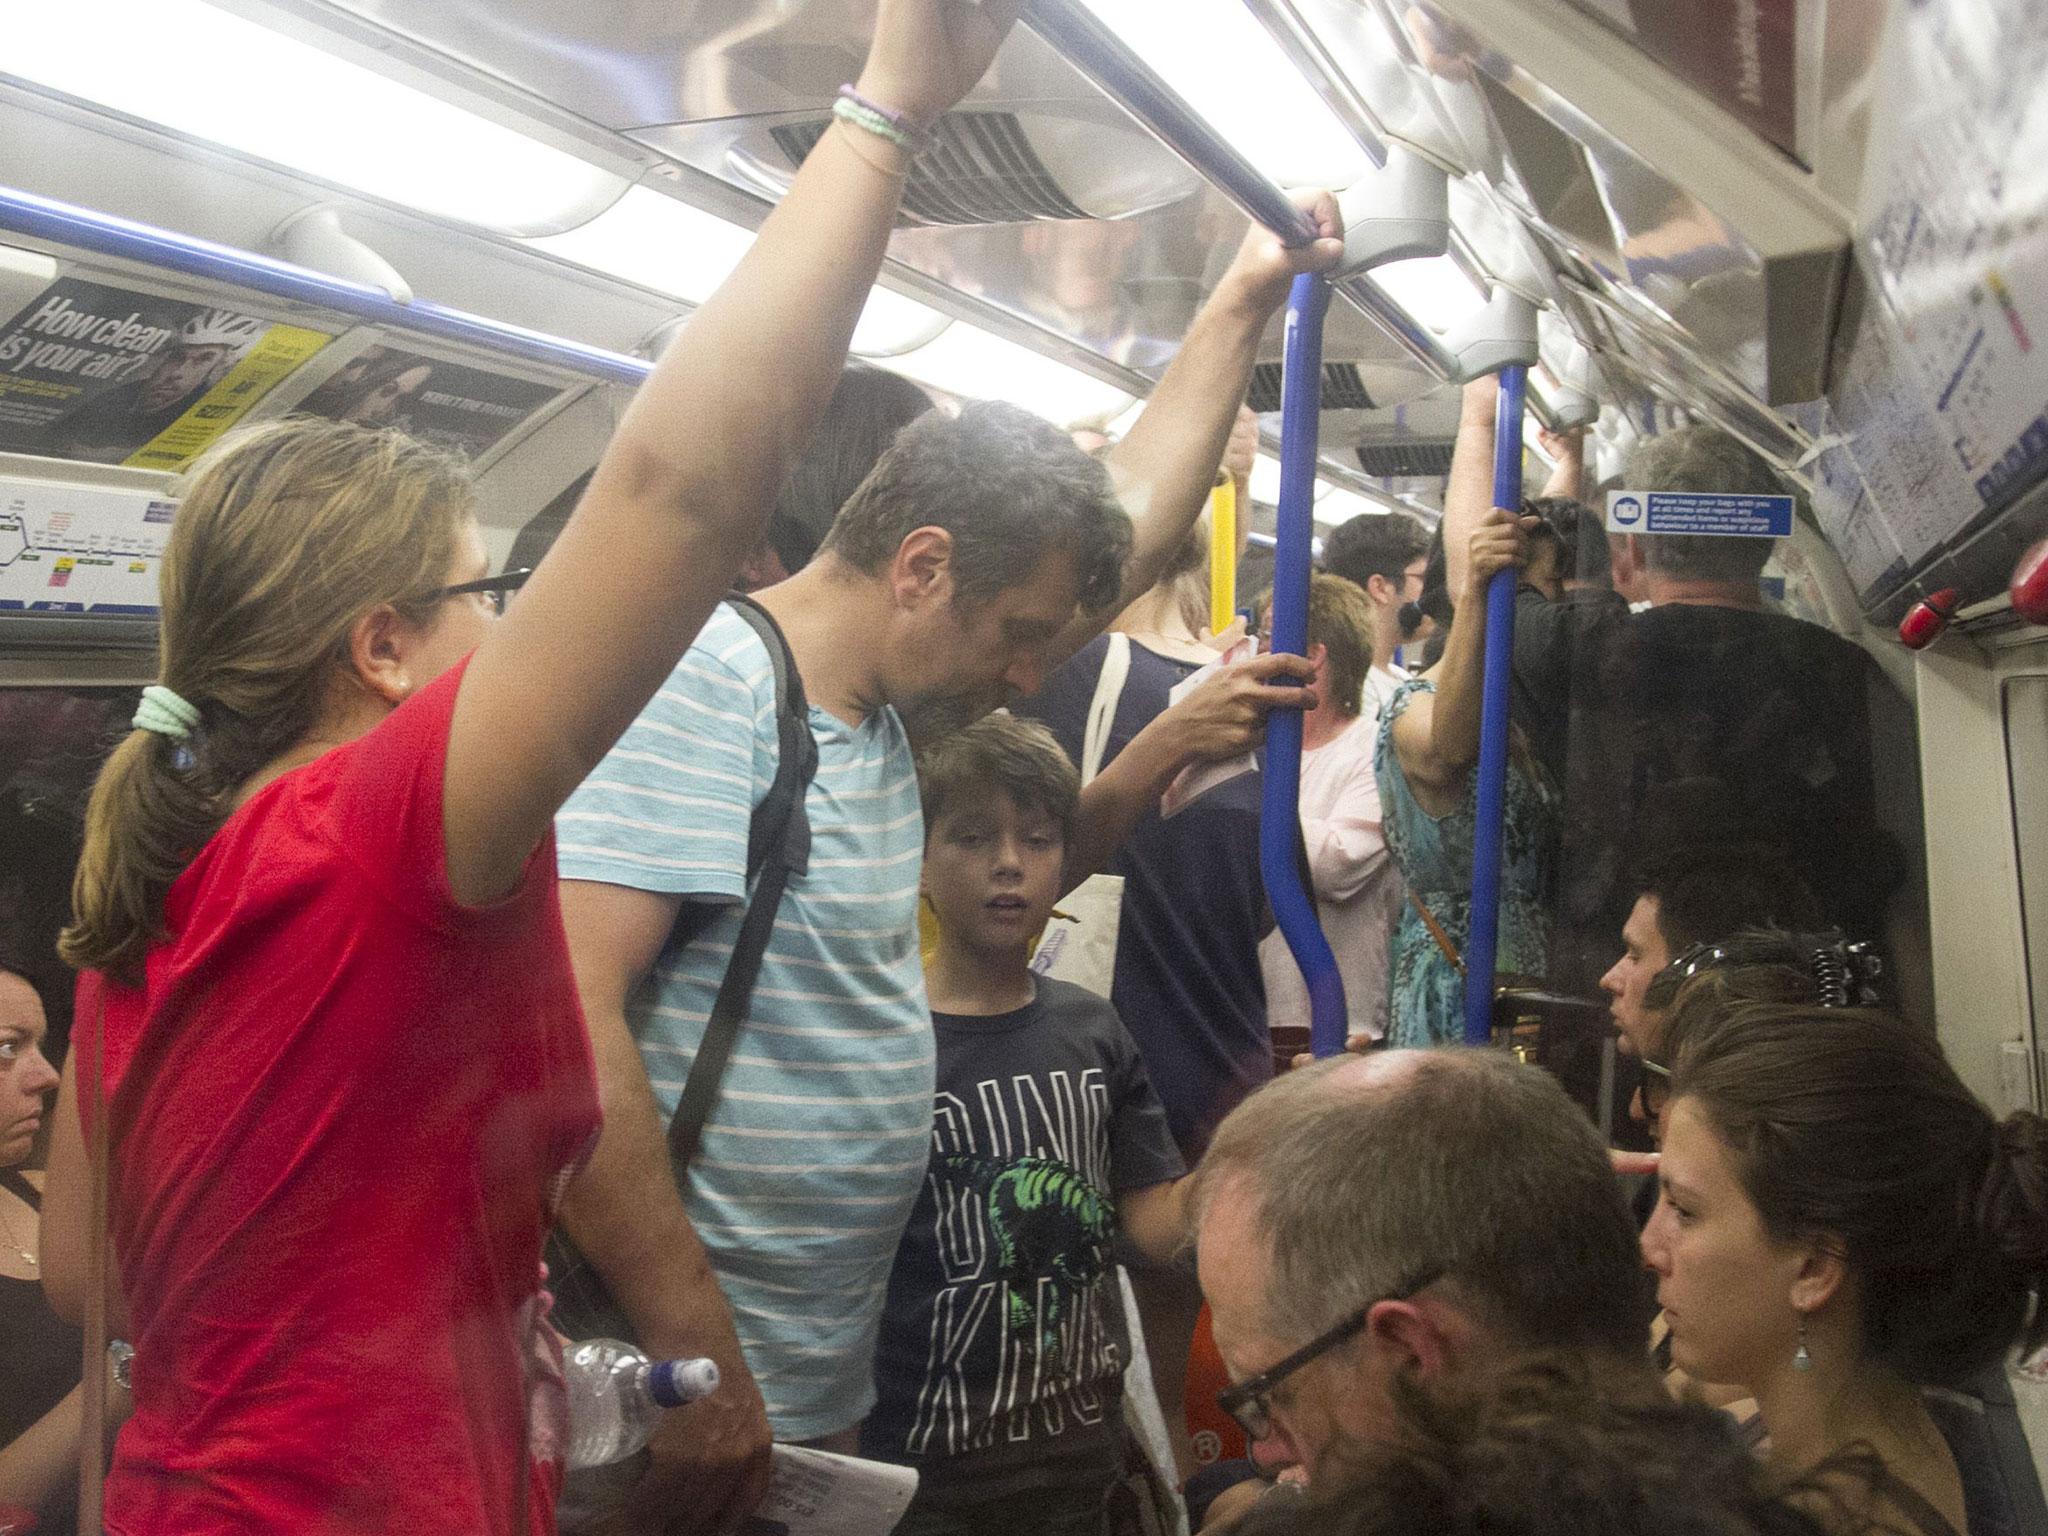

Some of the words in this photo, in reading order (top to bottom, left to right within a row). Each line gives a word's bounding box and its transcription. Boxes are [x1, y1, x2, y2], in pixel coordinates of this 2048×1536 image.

[22, 296, 95, 340] How
[91, 313, 172, 354] clean
[0, 328, 31, 360] is
[10, 340, 96, 372] your
[80, 350, 150, 382] air?
[1652, 496, 1677, 505] Please
[1678, 498, 1697, 506] keep
[1699, 499, 1716, 508] your
[1717, 499, 1735, 508] bags
[1755, 501, 1771, 509] you
[904, 1276, 1120, 1456] KING
